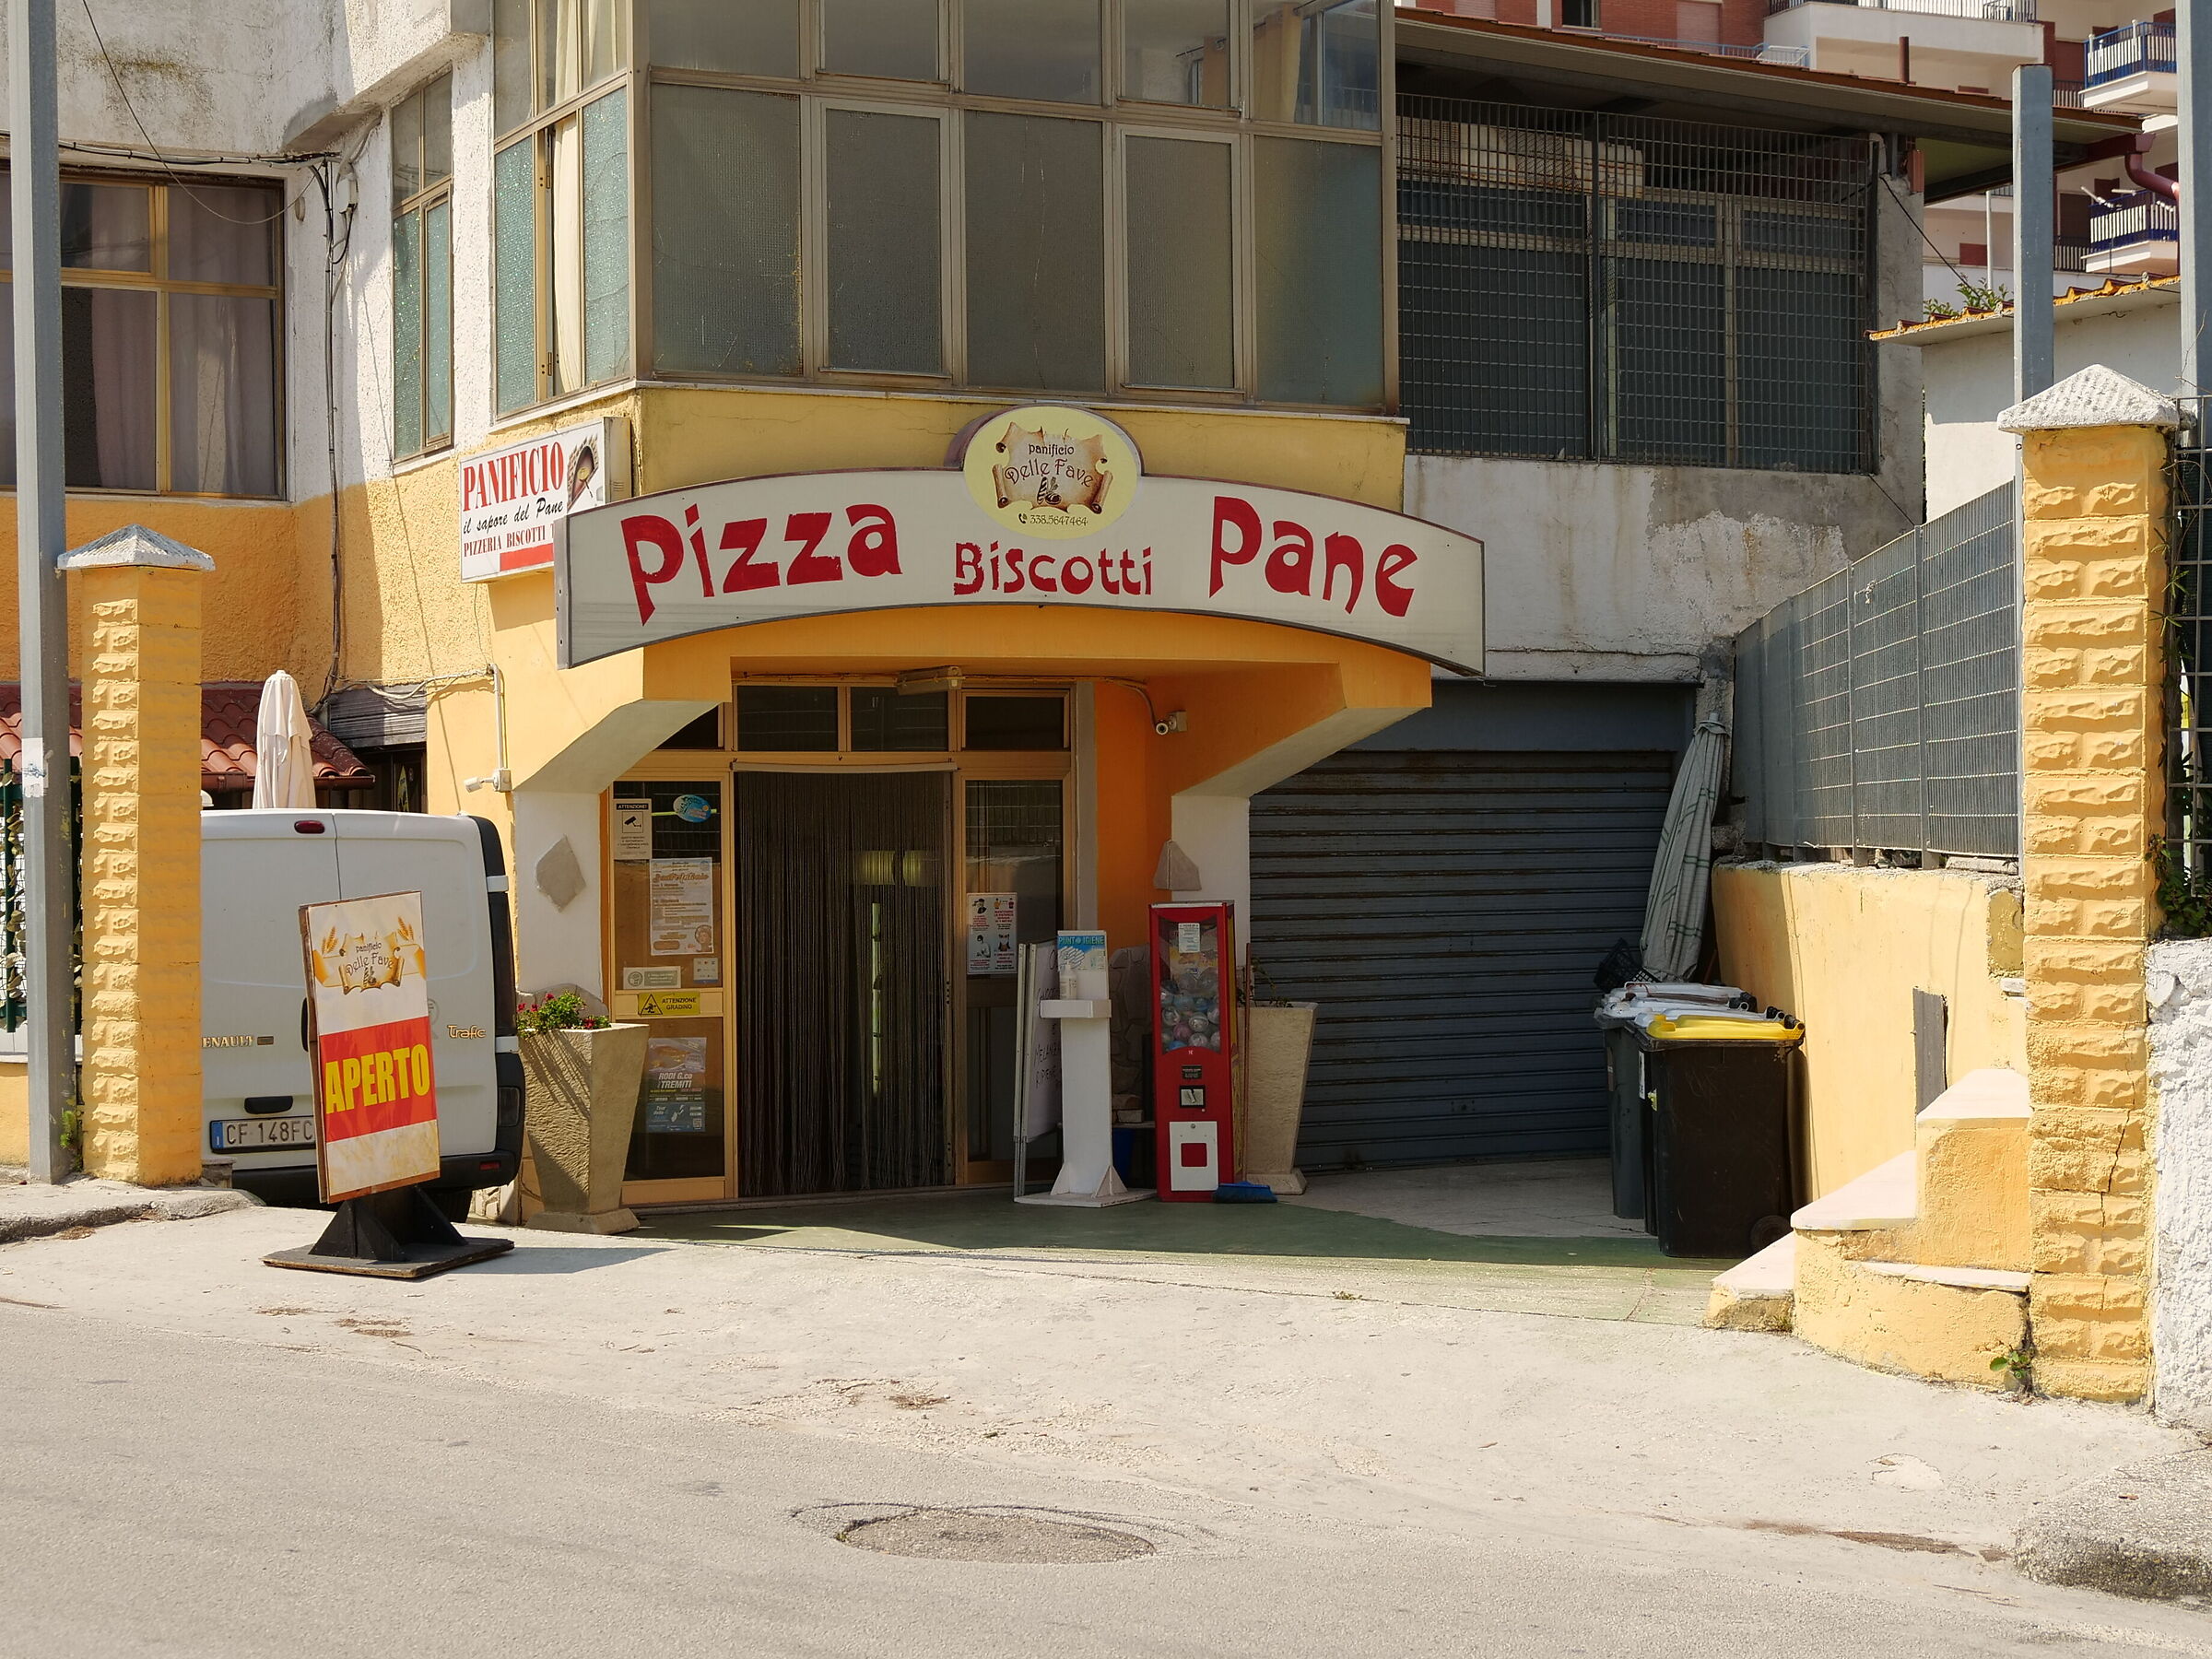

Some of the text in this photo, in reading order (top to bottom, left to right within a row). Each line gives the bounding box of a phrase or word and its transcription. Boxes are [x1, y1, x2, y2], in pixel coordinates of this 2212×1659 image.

[1029, 443, 1075, 458] panificio
[463, 441, 564, 512] PANIFICIO
[1004, 458, 1094, 488] Delle Fave
[463, 497, 564, 535] il sapore del Pane
[464, 535, 502, 558] PIZZERIA
[506, 524, 546, 548] BISCOTTI
[620, 503, 903, 627] Pizza
[953, 540, 1152, 596] Biscotti
[1209, 496, 1418, 618] Pane
[355, 942, 382, 953] panificio
[1083, 935, 1104, 945] IGIENE
[346, 951, 394, 976] Delle Fave
[202, 1036, 253, 1048] ENAULT
[447, 1024, 487, 1040] Trafic
[325, 1043, 430, 1114] APERTO
[660, 1080, 692, 1088] TREMITI
[226, 1120, 313, 1145] CF 148FC
